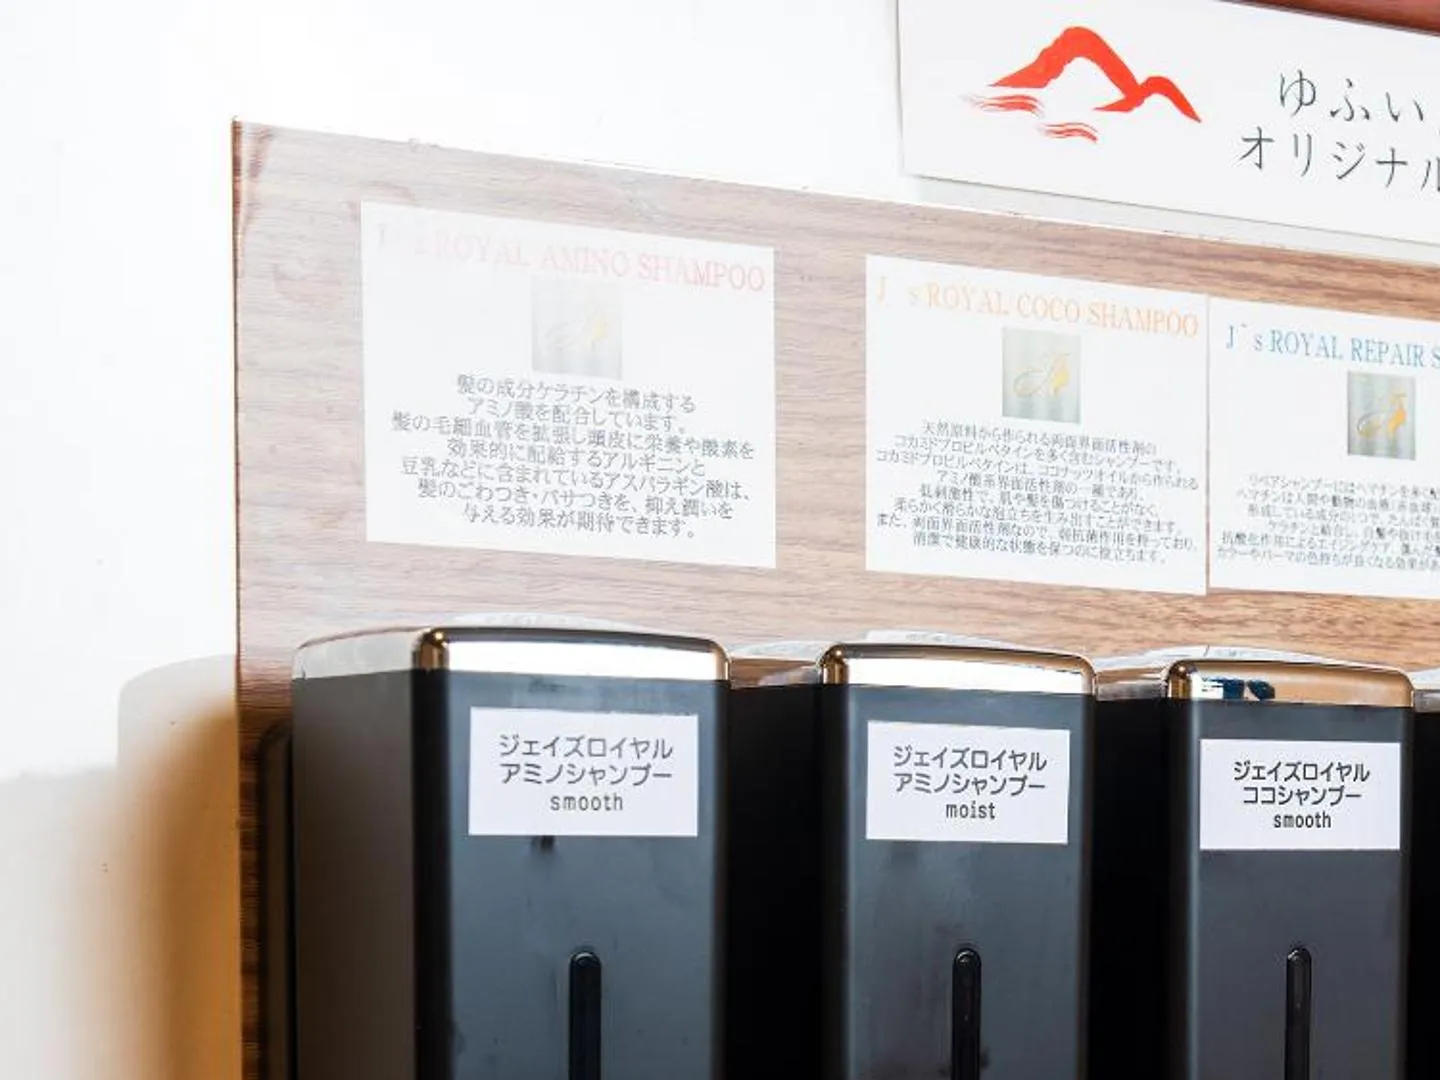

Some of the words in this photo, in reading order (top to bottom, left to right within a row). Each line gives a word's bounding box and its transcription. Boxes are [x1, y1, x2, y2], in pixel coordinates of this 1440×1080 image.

[638, 253, 766, 292] SHAMPOO
[927, 281, 1009, 317] ROYAL
[1017, 293, 1081, 325] COCO
[1087, 303, 1199, 338] SHAMPOO
[1270, 329, 1344, 360] ROYAL
[1351, 337, 1425, 368] REPAIR
[499, 733, 673, 760] ジェイズロイヤル
[893, 744, 1048, 772] ジェイズロイヤル
[500, 762, 673, 787] アミノシャンプー
[1233, 759, 1371, 782] ジェイズロイヤル
[893, 772, 1046, 796] アミノシャンプー
[1243, 785, 1362, 806] ココシャンプー
[549, 792, 624, 811] smooth
[945, 801, 996, 819] moist
[1273, 811, 1332, 829] smooth
